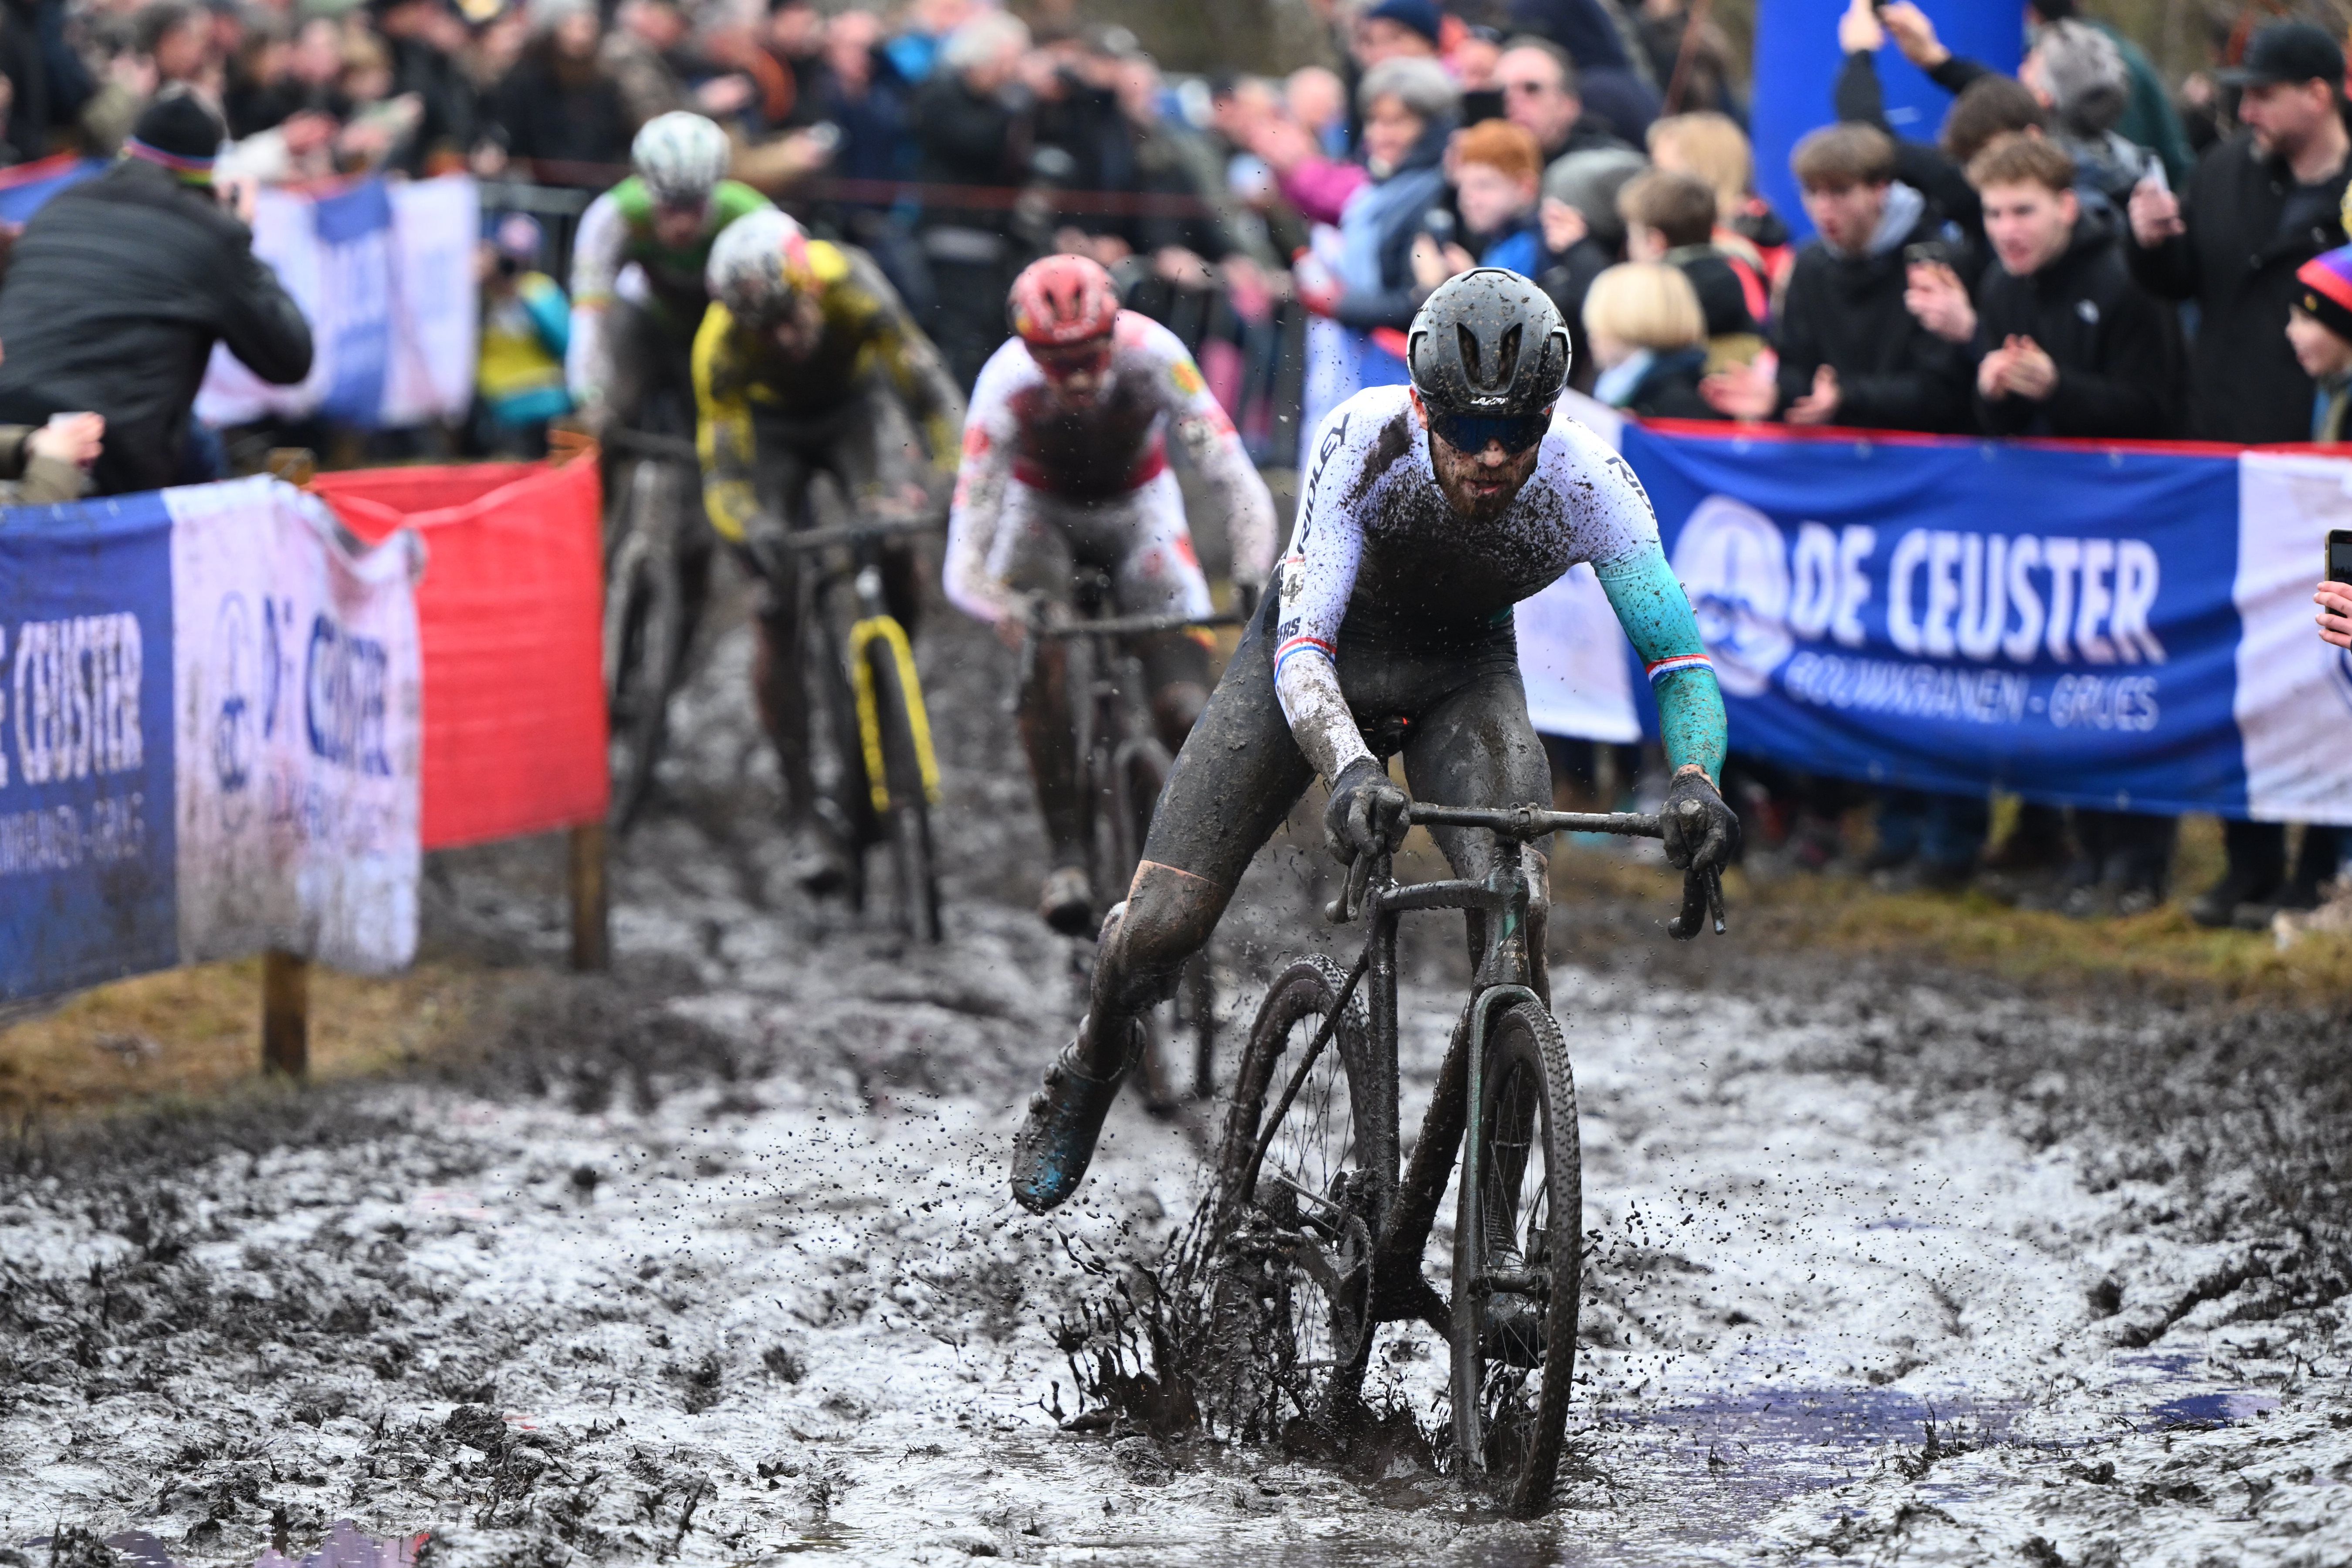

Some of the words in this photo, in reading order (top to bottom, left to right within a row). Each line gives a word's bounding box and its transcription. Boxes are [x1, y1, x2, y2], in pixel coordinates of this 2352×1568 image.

[1297, 412, 1351, 555] RIDLEY
[1275, 616, 1301, 652] ERS
[1789, 522, 1876, 649] DE
[1887, 527, 2167, 664] CEUSTER
[14, 611, 143, 785] CEUSTER
[2049, 673, 2160, 731] GRUES
